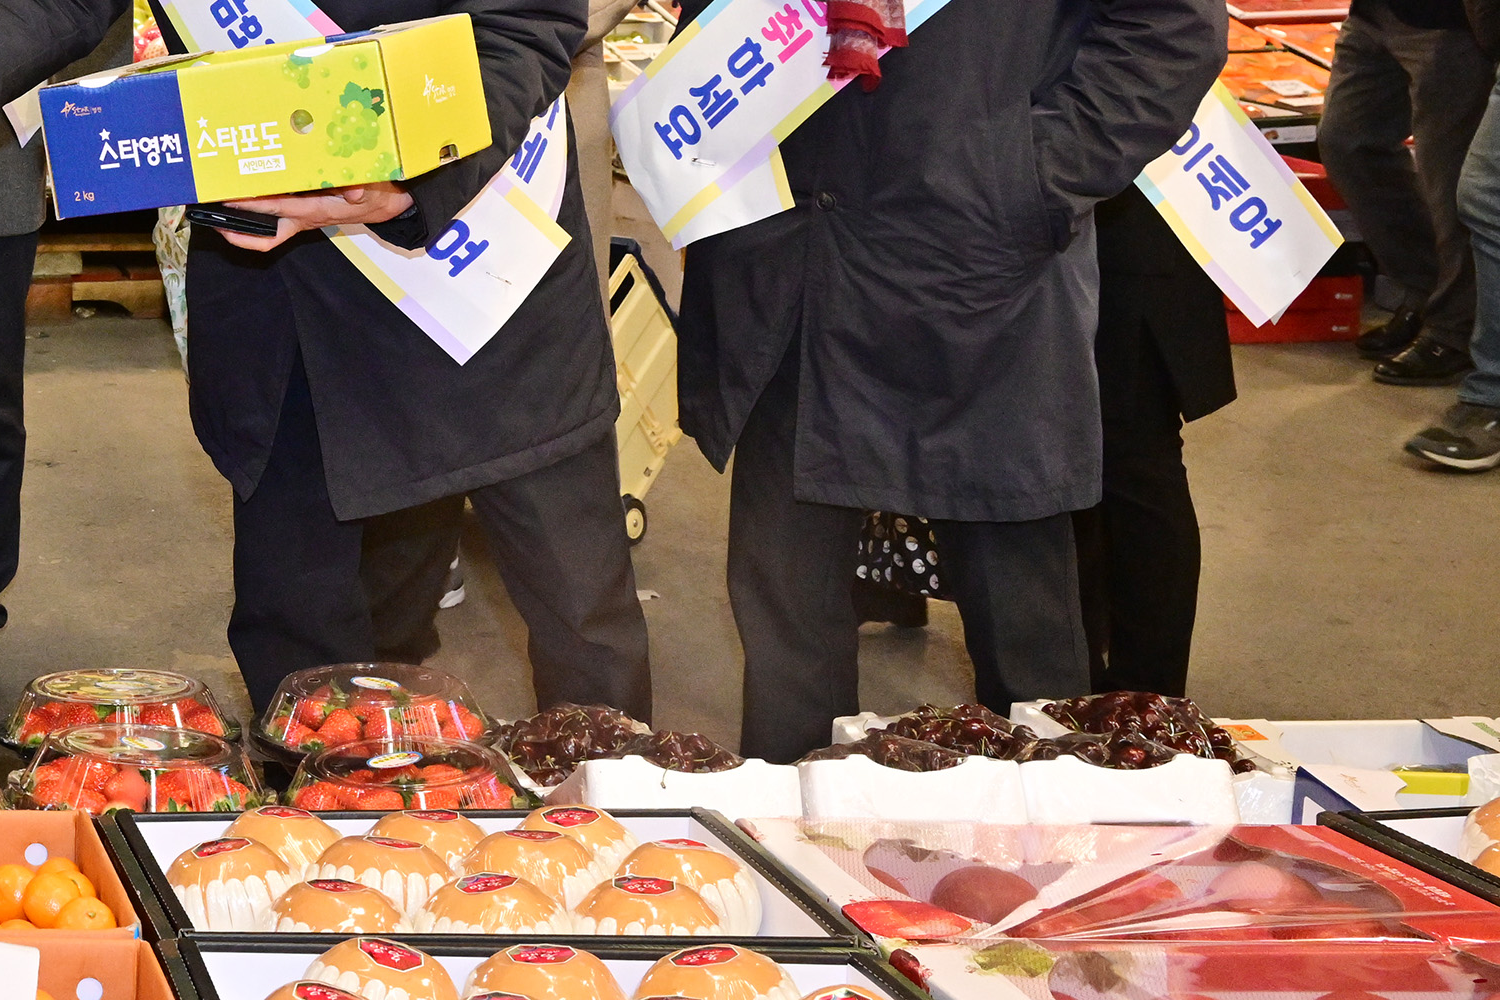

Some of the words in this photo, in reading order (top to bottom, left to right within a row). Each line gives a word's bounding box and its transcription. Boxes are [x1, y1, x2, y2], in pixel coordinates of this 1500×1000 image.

[654, 37, 774, 160] 하세요
[100, 131, 184, 170] 스타영천
[196, 120, 283, 158] 스타포도
